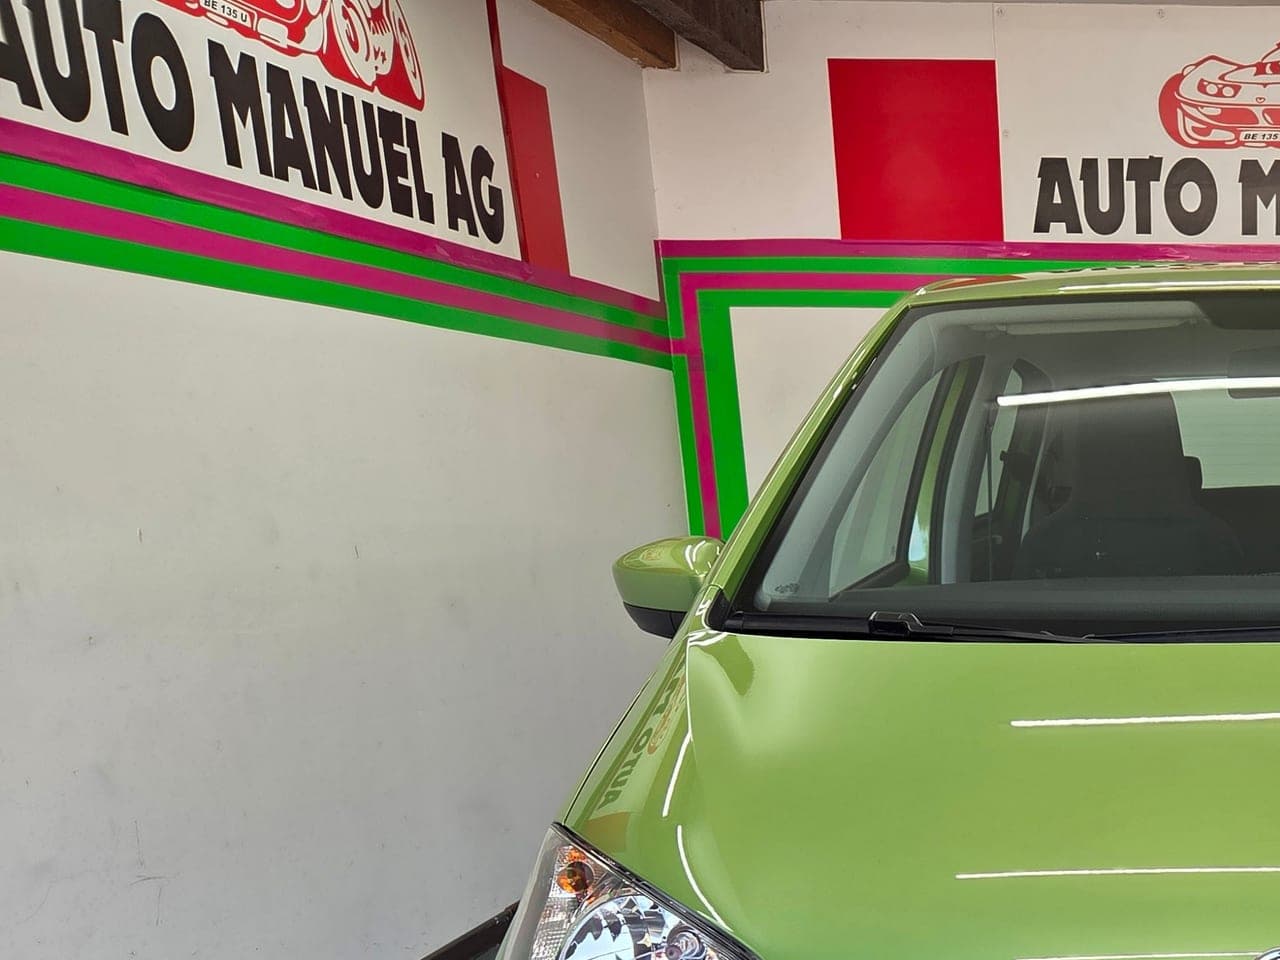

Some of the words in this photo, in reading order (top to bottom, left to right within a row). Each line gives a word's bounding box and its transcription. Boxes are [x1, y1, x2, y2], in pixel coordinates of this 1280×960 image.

[204, 0, 217, 10] BE
[221, 5, 238, 19] 135
[240, 13, 248, 22] U
[207, 38, 435, 225] MANUEL
[442, 132, 504, 245] AG
[1033, 155, 1218, 237] AUTO
